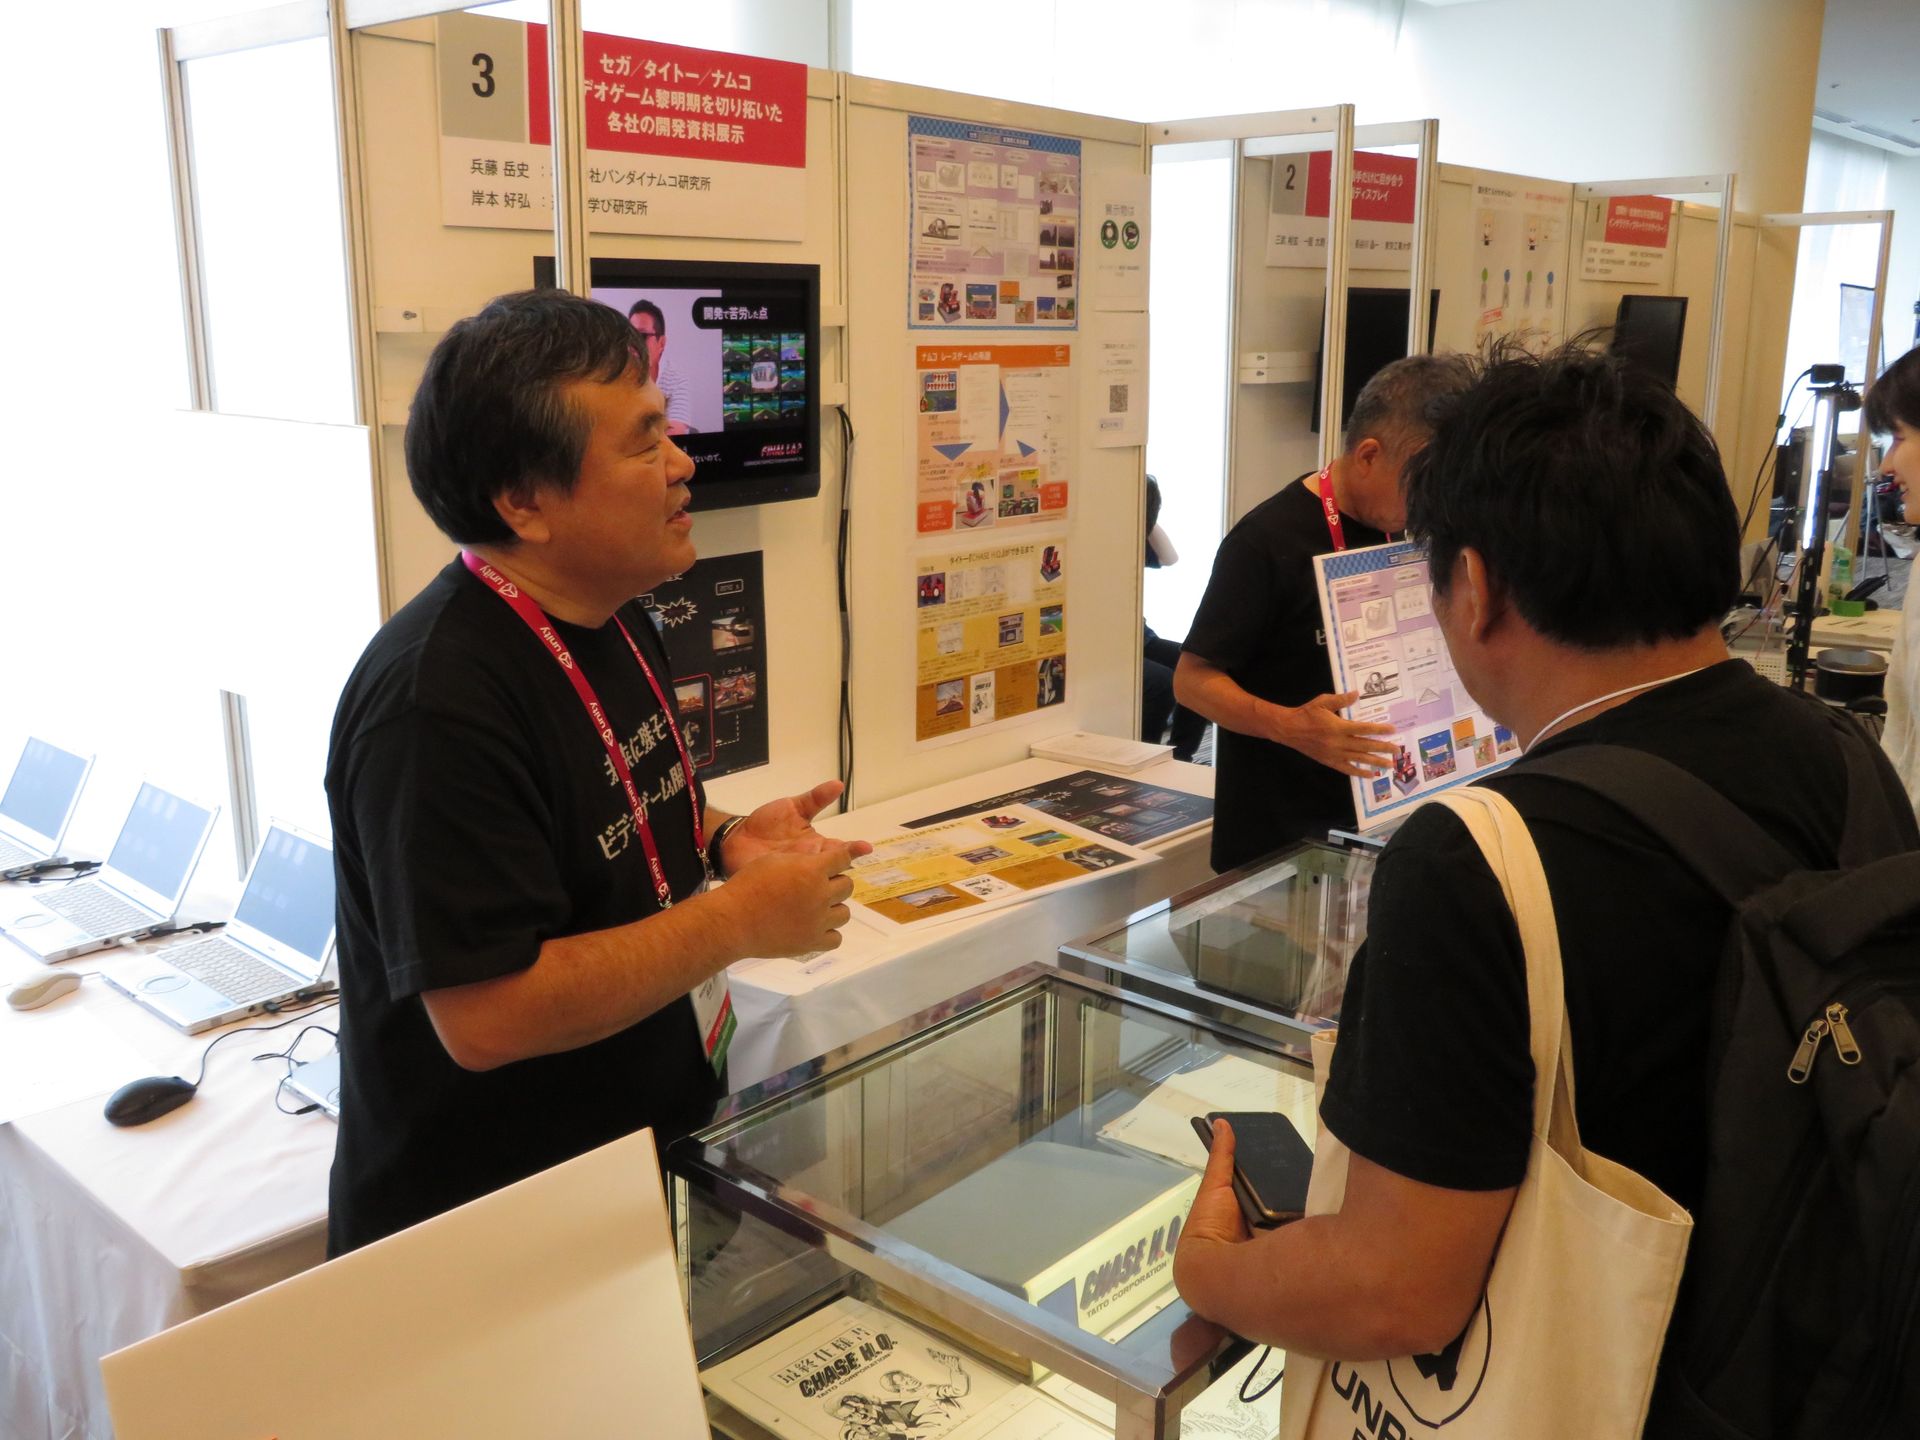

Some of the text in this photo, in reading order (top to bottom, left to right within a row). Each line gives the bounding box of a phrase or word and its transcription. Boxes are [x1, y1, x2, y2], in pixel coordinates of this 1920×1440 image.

[471, 53, 496, 98] 3
[599, 53, 752, 91] セガ／タイトー／ナムコ
[607, 111, 745, 145] 各社の開発資料展示
[470, 158, 530, 178] 兵藤 岳史
[1285, 164, 1296, 190] 2
[471, 190, 531, 209] 岸本 好弘
[703, 306, 768, 320] 開発で苦労した点
[479, 564, 503, 586] unity
[540, 626, 562, 653] unity
[590, 702, 607, 729] unity
[625, 780, 638, 807] unity
[1087, 1260, 1168, 1318] TAITO CORPORATION
[799, 1351, 861, 1398] CHASE
